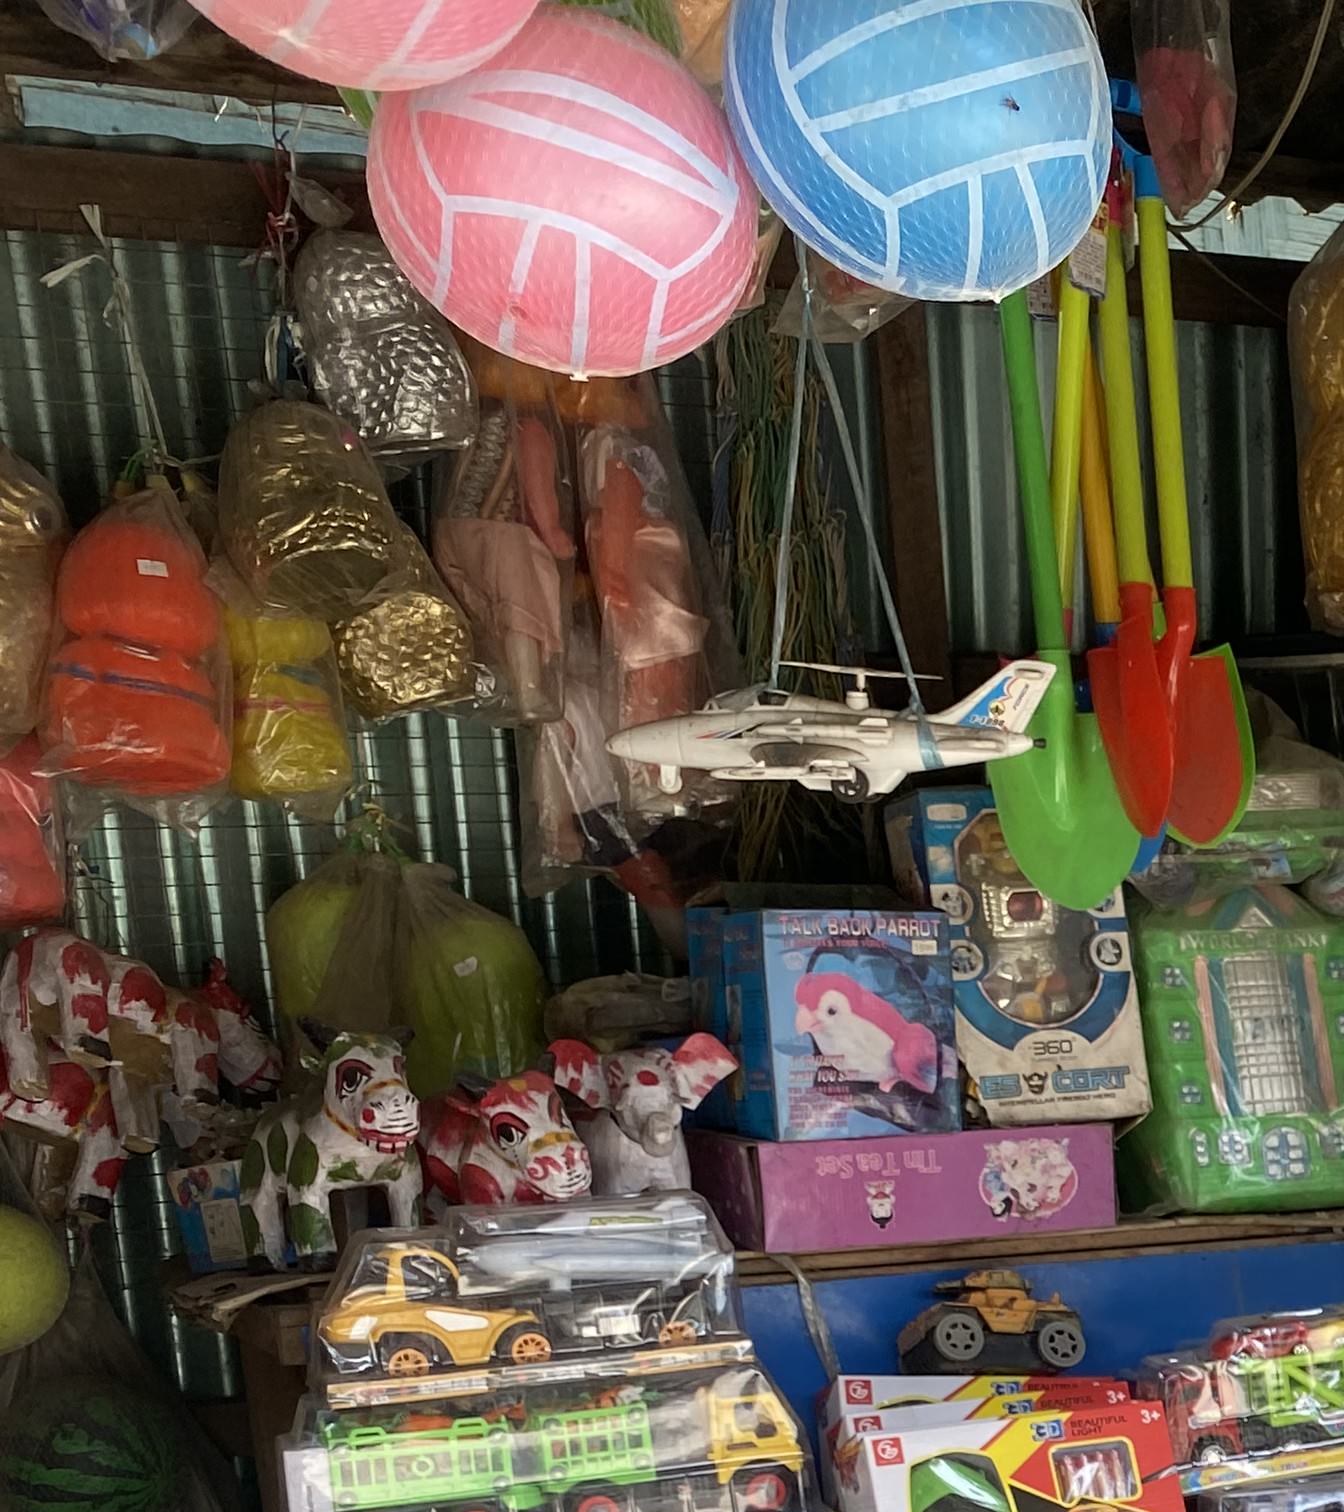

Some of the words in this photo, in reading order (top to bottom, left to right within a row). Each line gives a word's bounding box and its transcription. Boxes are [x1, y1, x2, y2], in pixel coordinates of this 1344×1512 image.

[779, 915, 822, 937] TALK
[875, 917, 942, 938] PARROT
[855, 1151, 901, 1177] Tea
[903, 1148, 943, 1174] Tin
[1106, 1390, 1126, 1404] 3+
[1070, 1415, 1128, 1430] BEAUTIFUL
[1140, 1409, 1161, 1424] 3+
[1070, 1425, 1103, 1437] LIGHT
